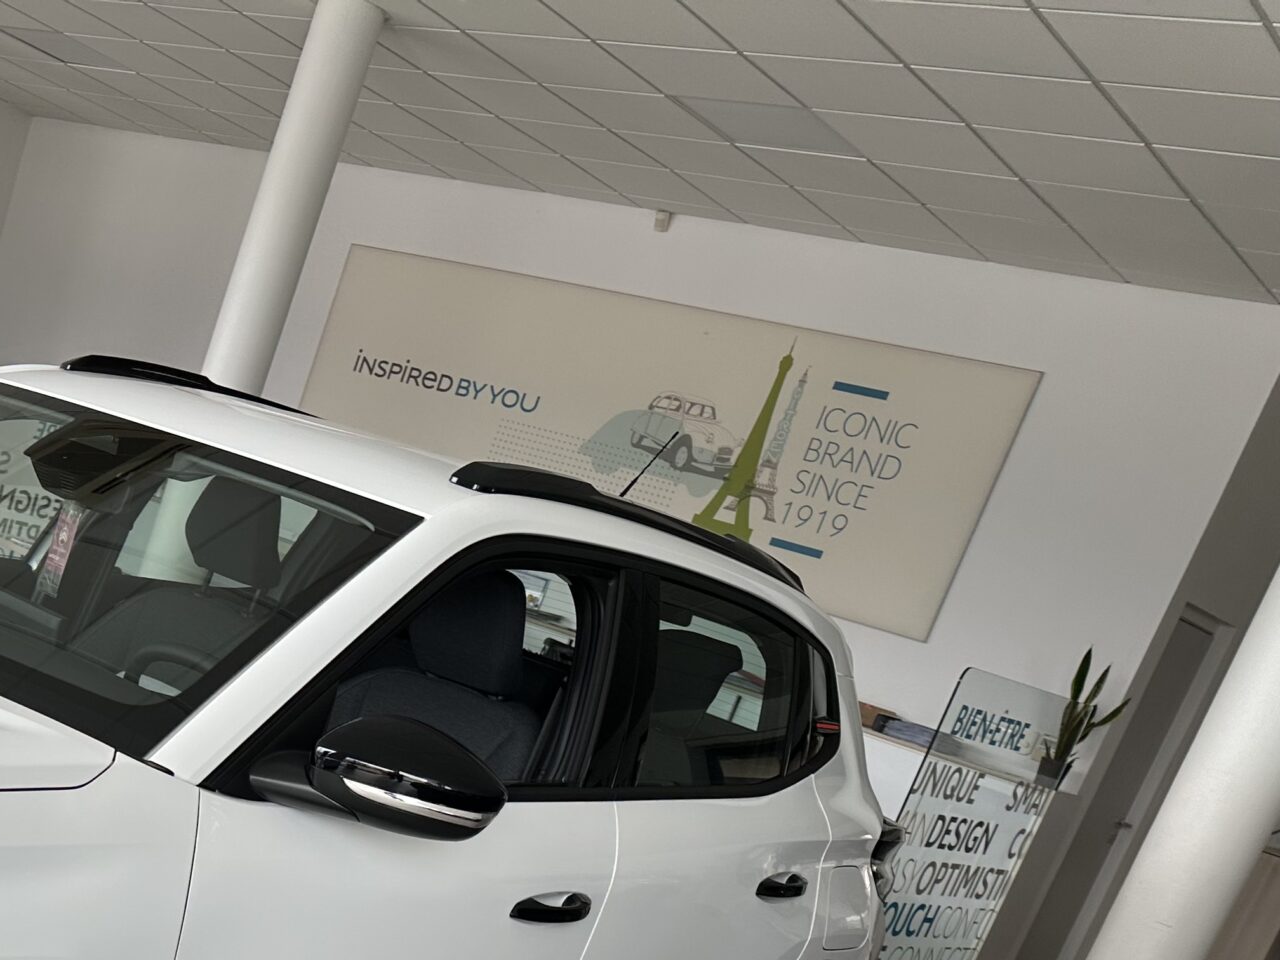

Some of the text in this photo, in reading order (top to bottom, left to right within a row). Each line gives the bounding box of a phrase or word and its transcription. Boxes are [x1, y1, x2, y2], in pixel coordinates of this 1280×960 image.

[455, 378, 488, 400] BY
[490, 385, 541, 413] YOU
[816, 405, 919, 449] ICONIC
[803, 437, 902, 480] BRAND
[790, 470, 875, 511] SINCE
[782, 502, 849, 537] 1919
[951, 705, 1031, 751] BIEN-ÊTRE
[925, 814, 999, 855] DESIGN
[883, 902, 941, 937] OUCH
